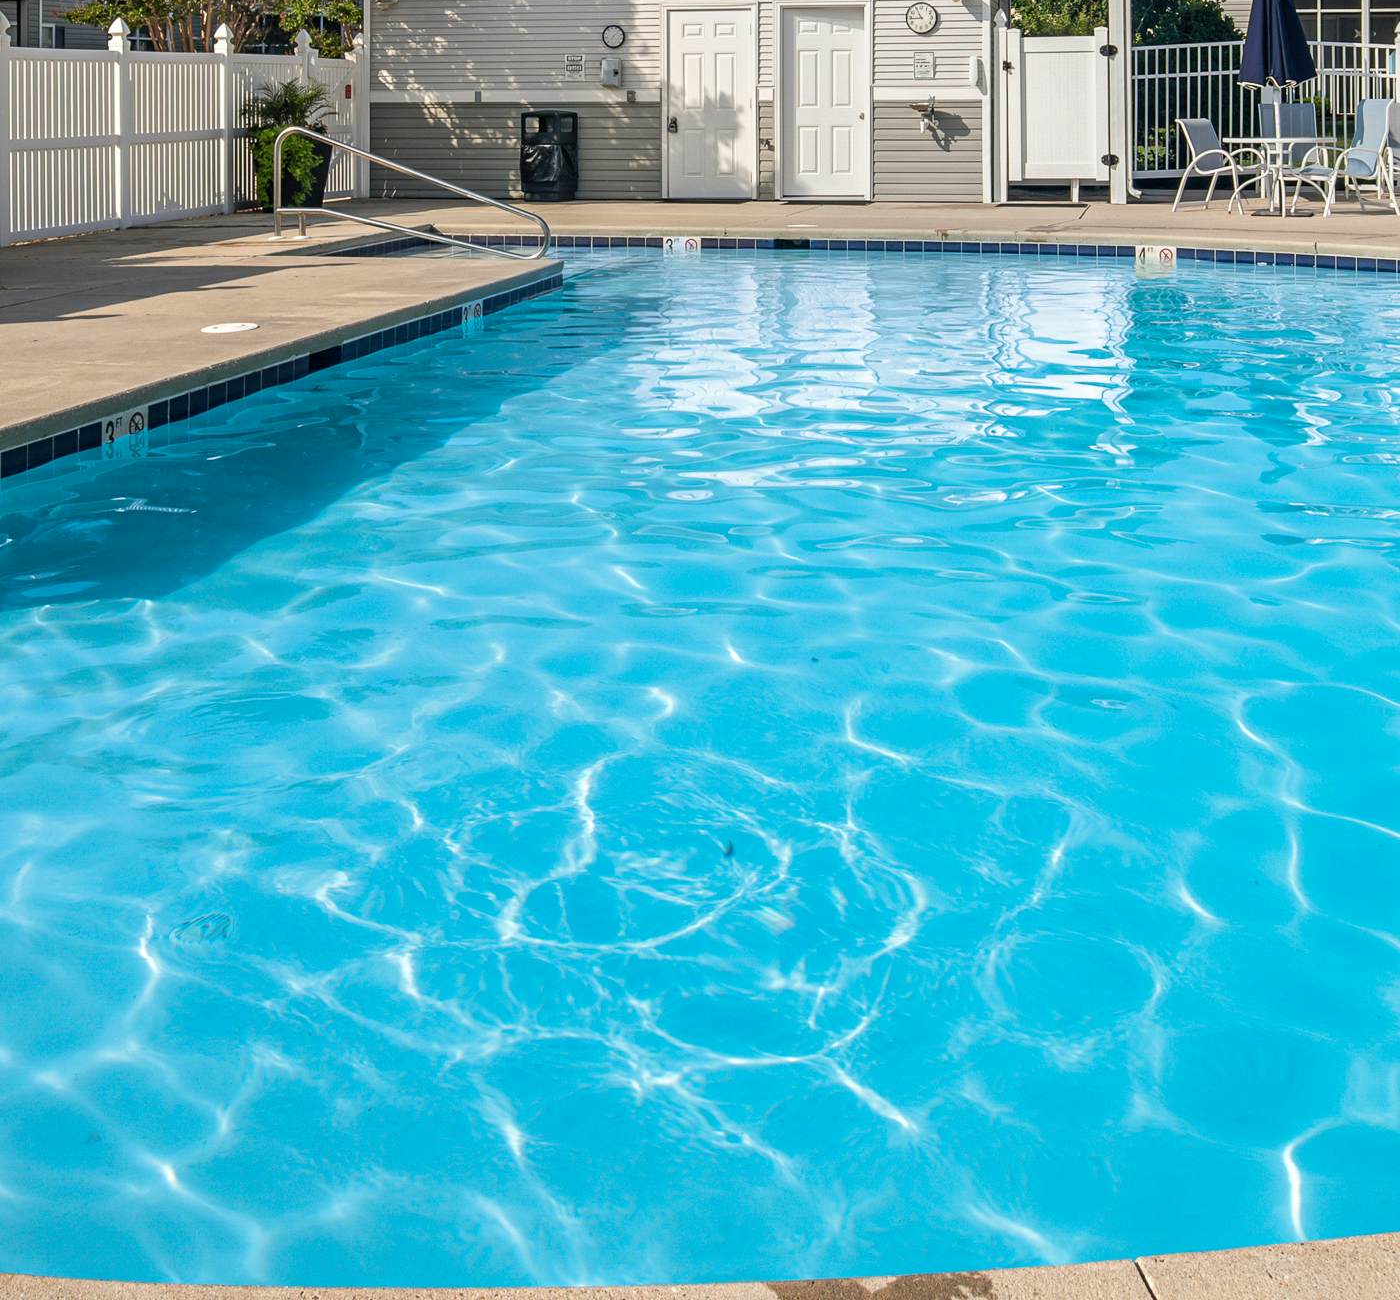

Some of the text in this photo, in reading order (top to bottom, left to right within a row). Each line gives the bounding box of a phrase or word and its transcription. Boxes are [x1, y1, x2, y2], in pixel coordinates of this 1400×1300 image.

[666, 238, 673, 252] 3
[105, 416, 123, 444] 3 FT
